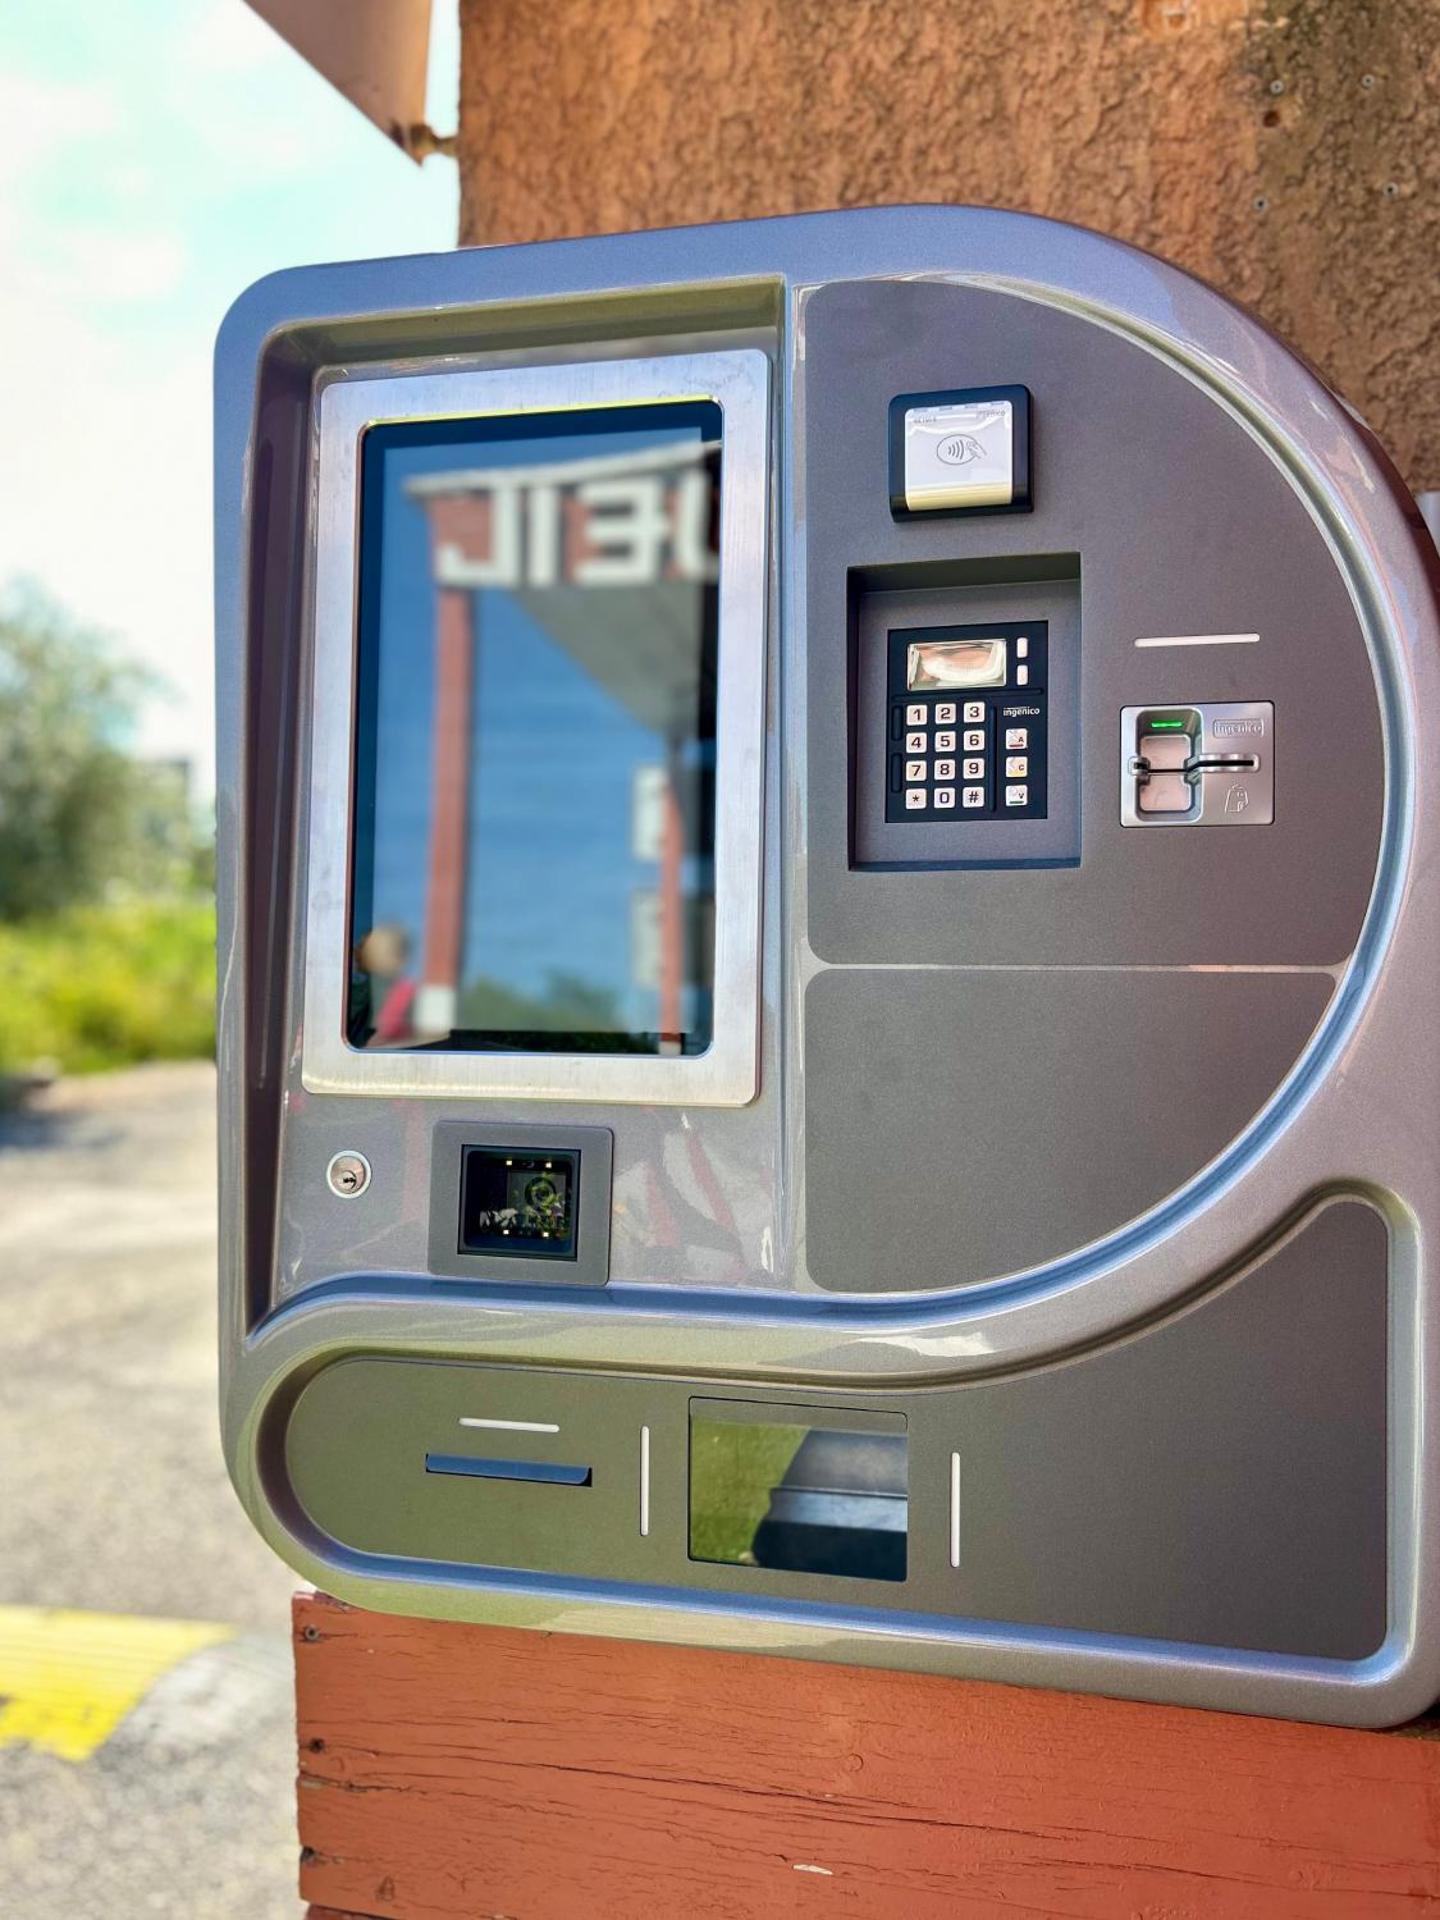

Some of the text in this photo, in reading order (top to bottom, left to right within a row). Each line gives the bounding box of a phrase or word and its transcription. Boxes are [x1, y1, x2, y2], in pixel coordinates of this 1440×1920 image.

[914, 707, 979, 720] 1 2 3
[1003, 706, 1040, 717] ingenico
[911, 735, 979, 748] 4 5 6
[912, 763, 978, 776] 7 8 9
[940, 792, 949, 803] 0
[969, 791, 979, 803] #
